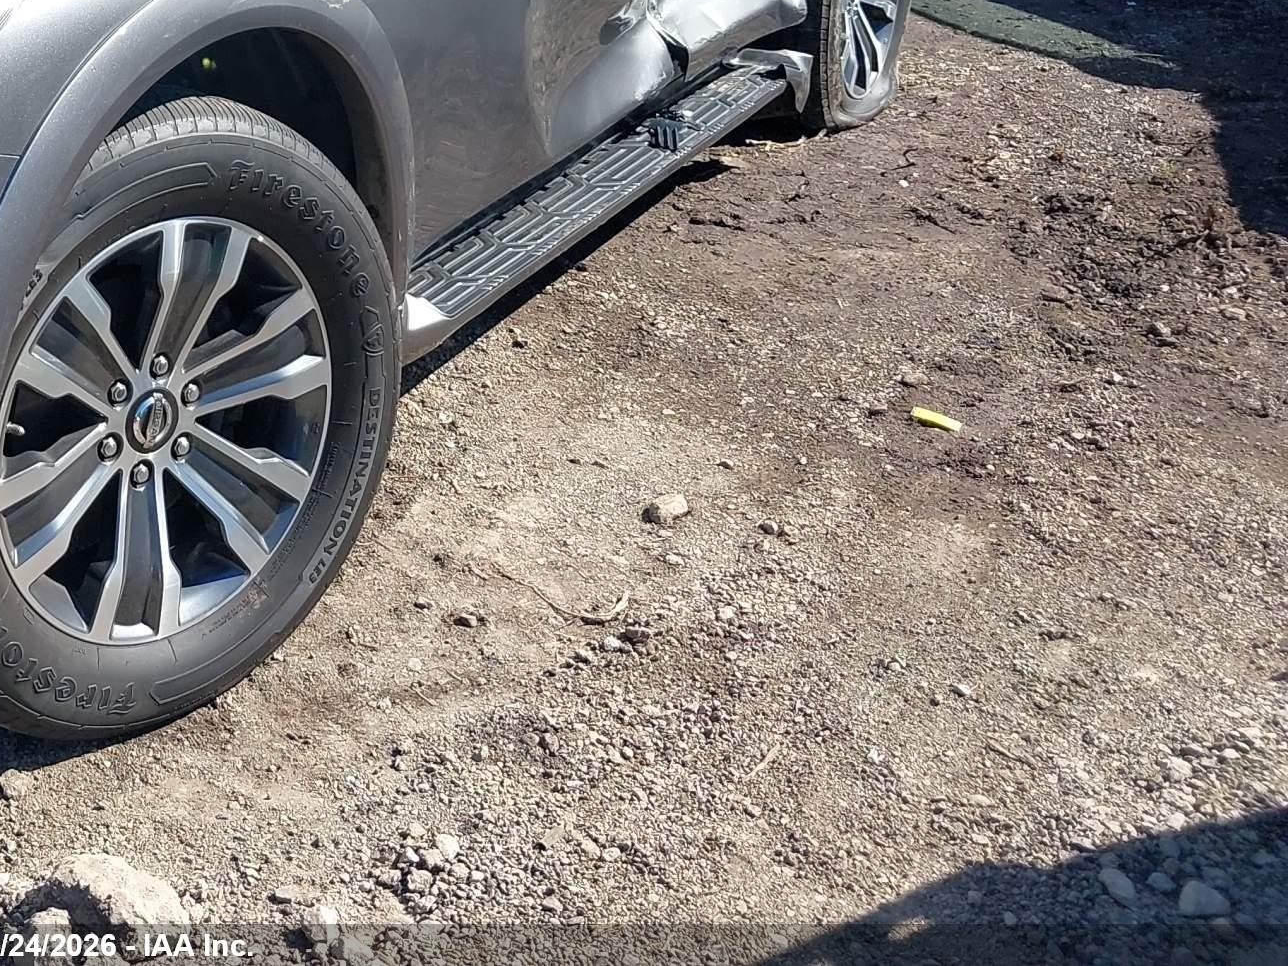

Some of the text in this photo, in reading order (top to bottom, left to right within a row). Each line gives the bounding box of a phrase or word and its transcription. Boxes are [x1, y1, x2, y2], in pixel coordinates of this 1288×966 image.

[228, 159, 370, 297] Firestone
[322, 388, 381, 556] DESTINATION
[309, 561, 326, 584] LE3
